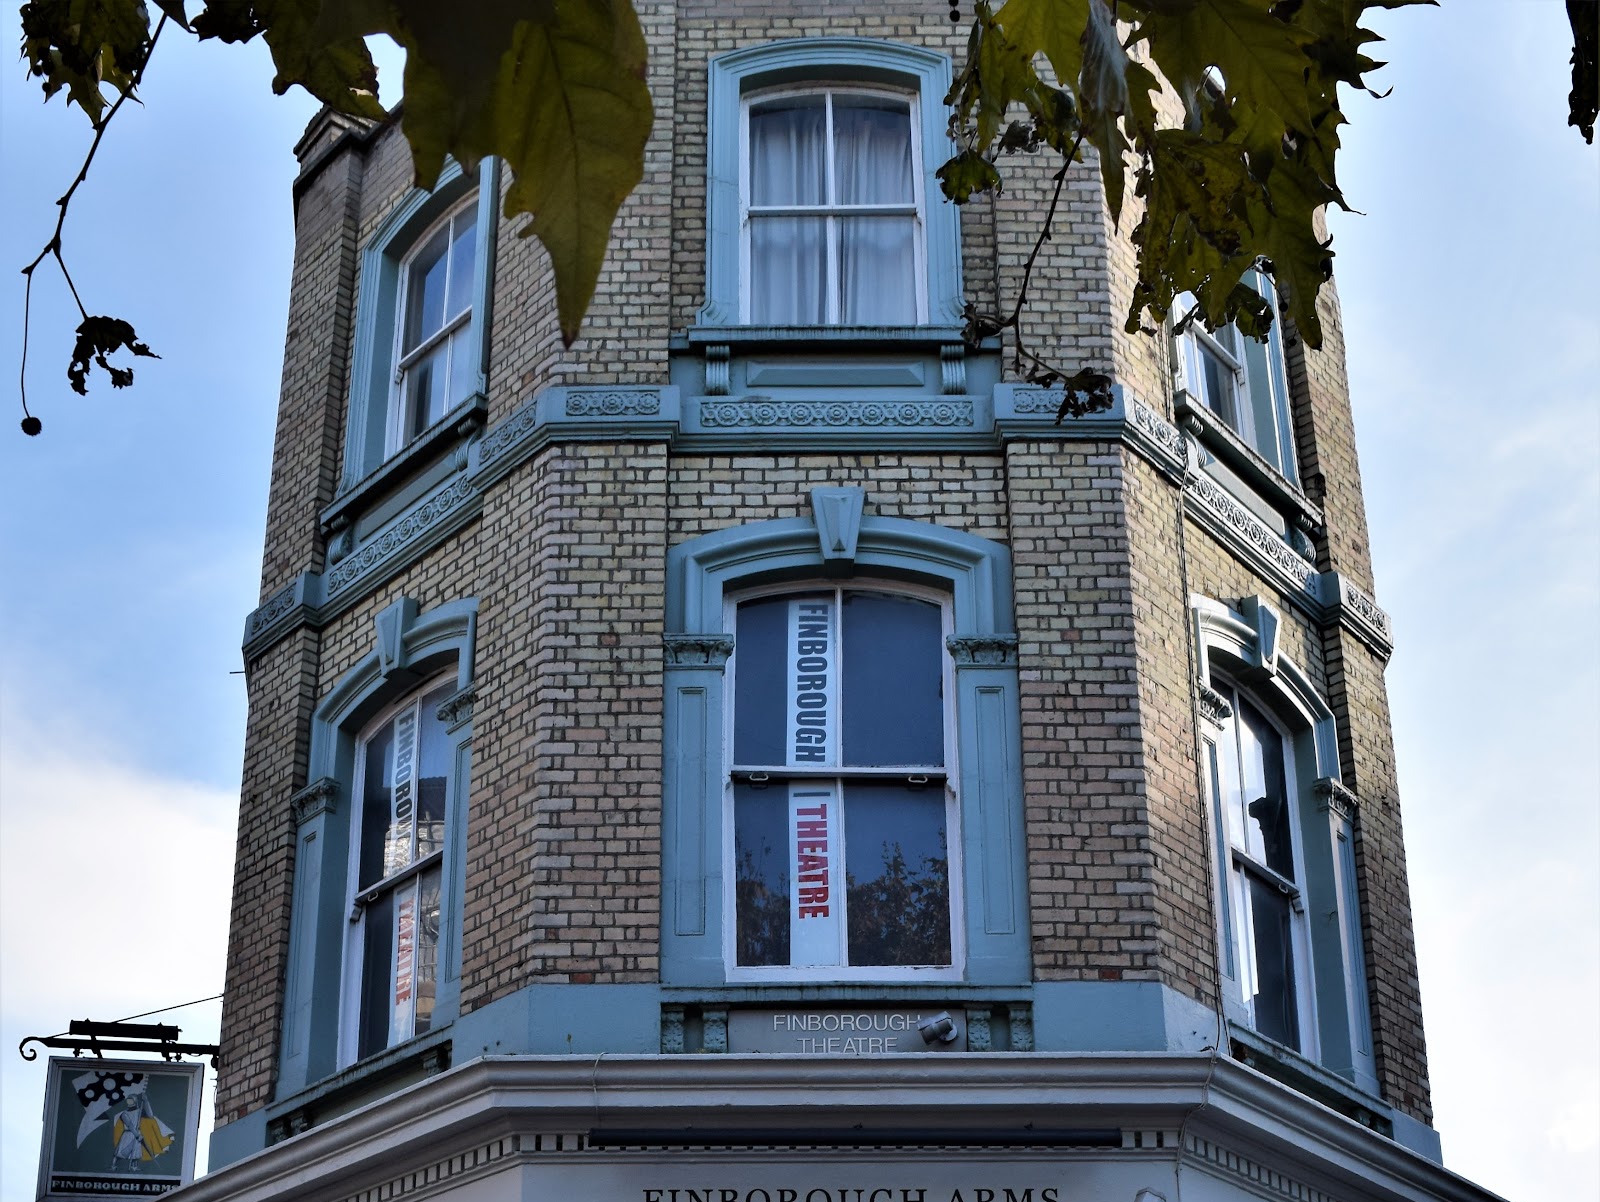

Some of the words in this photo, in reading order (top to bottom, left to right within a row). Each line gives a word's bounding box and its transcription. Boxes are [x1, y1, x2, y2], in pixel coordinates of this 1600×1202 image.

[795, 604, 829, 763] FINBOROUGH
[796, 803, 830, 920] THEATRE
[796, 1037, 898, 1053] THEATRE
[51, 1180, 141, 1192] FINBOROUGH
